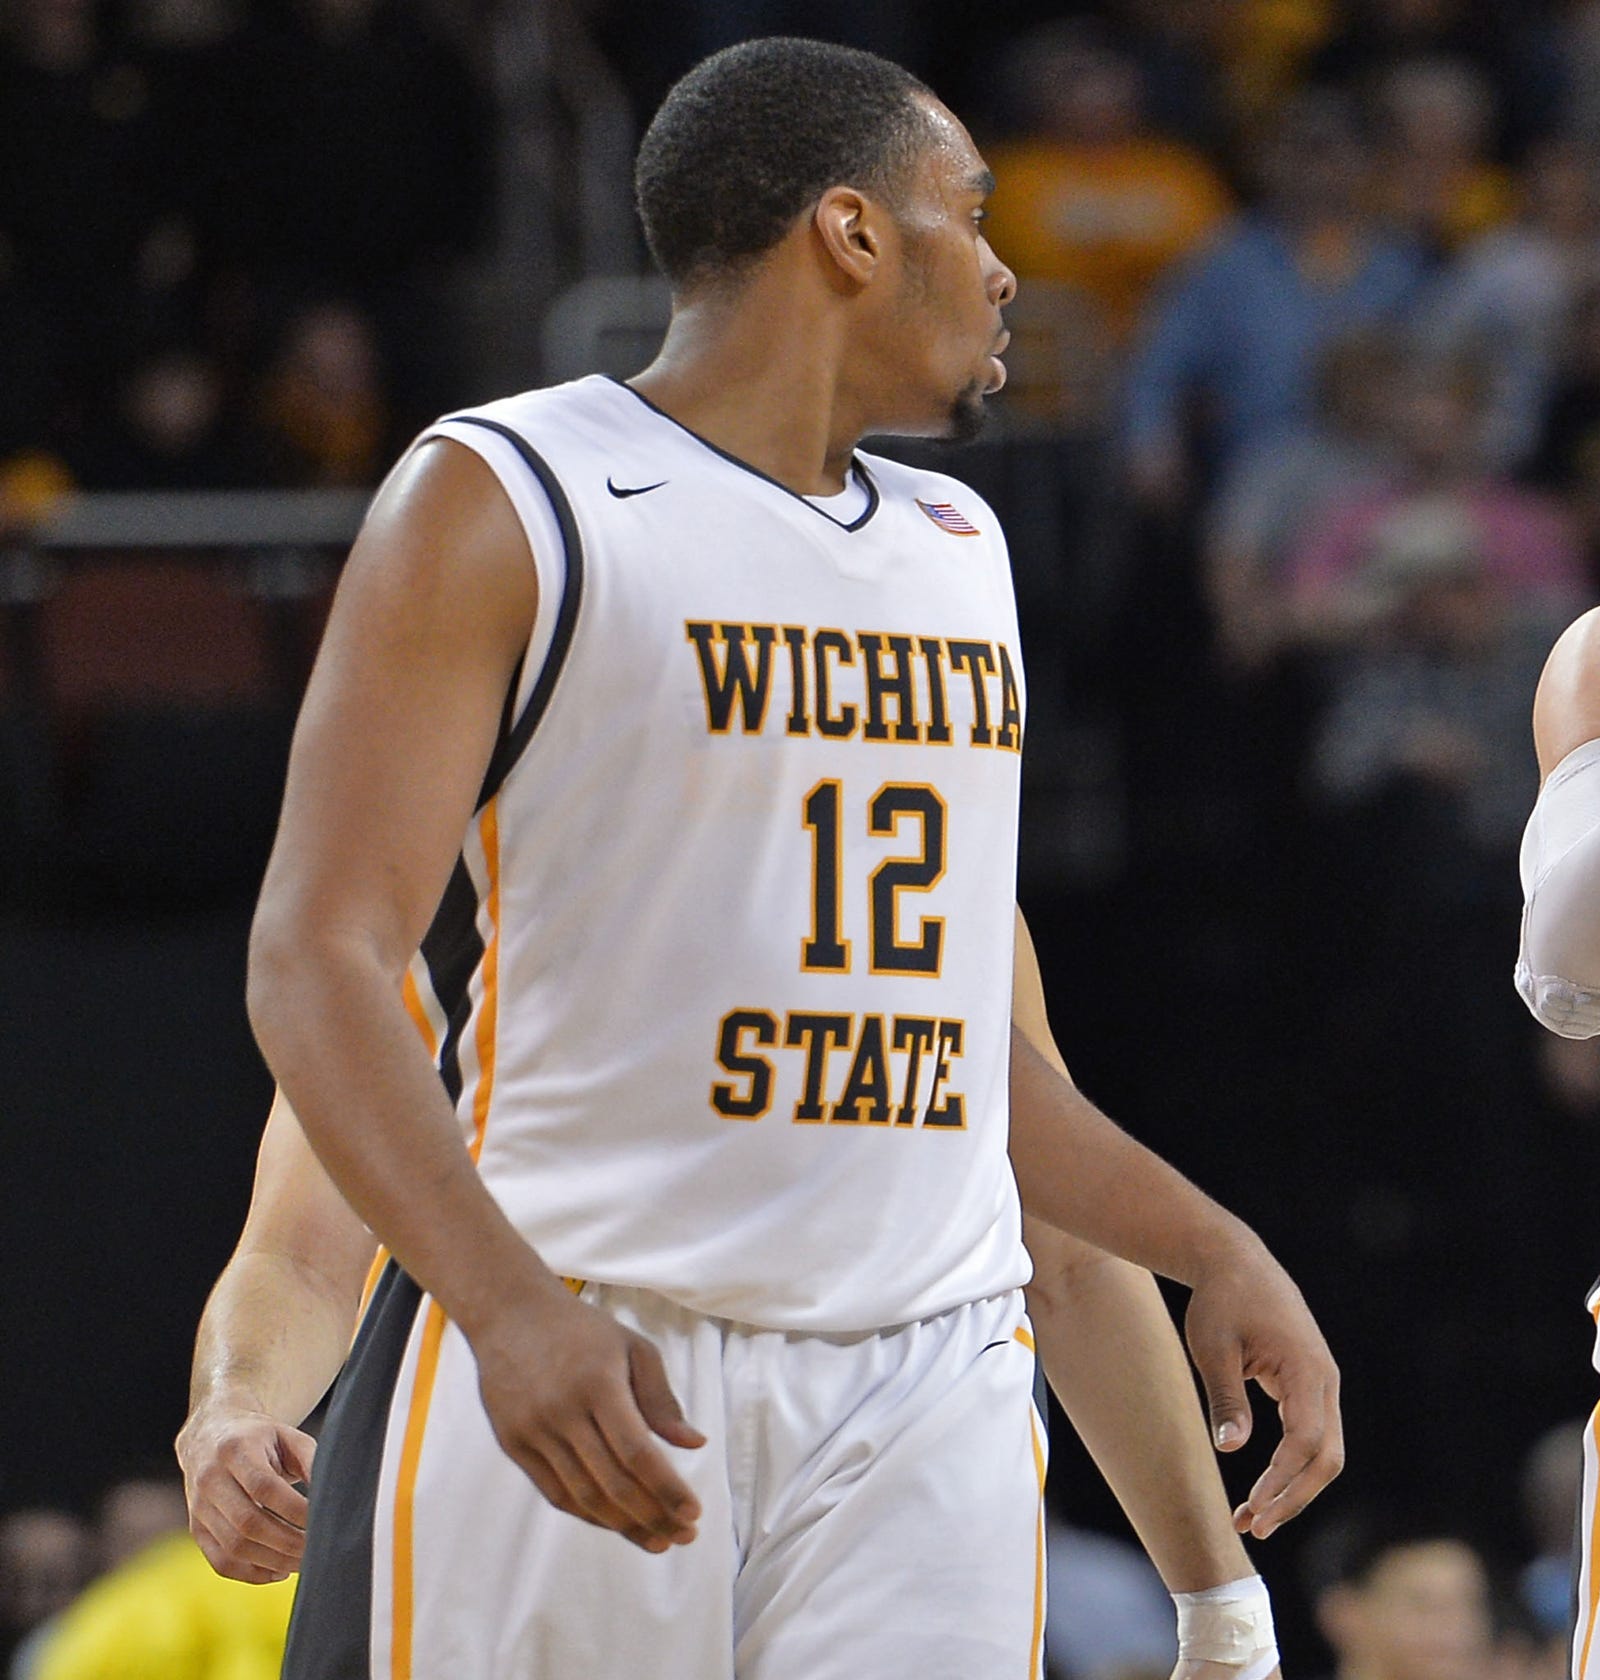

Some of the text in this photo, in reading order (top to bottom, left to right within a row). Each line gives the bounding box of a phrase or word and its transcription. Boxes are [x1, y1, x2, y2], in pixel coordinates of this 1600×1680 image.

[684, 619, 1022, 754] WICHITA
[801, 778, 947, 978] 12
[709, 1007, 968, 1131] STATE
